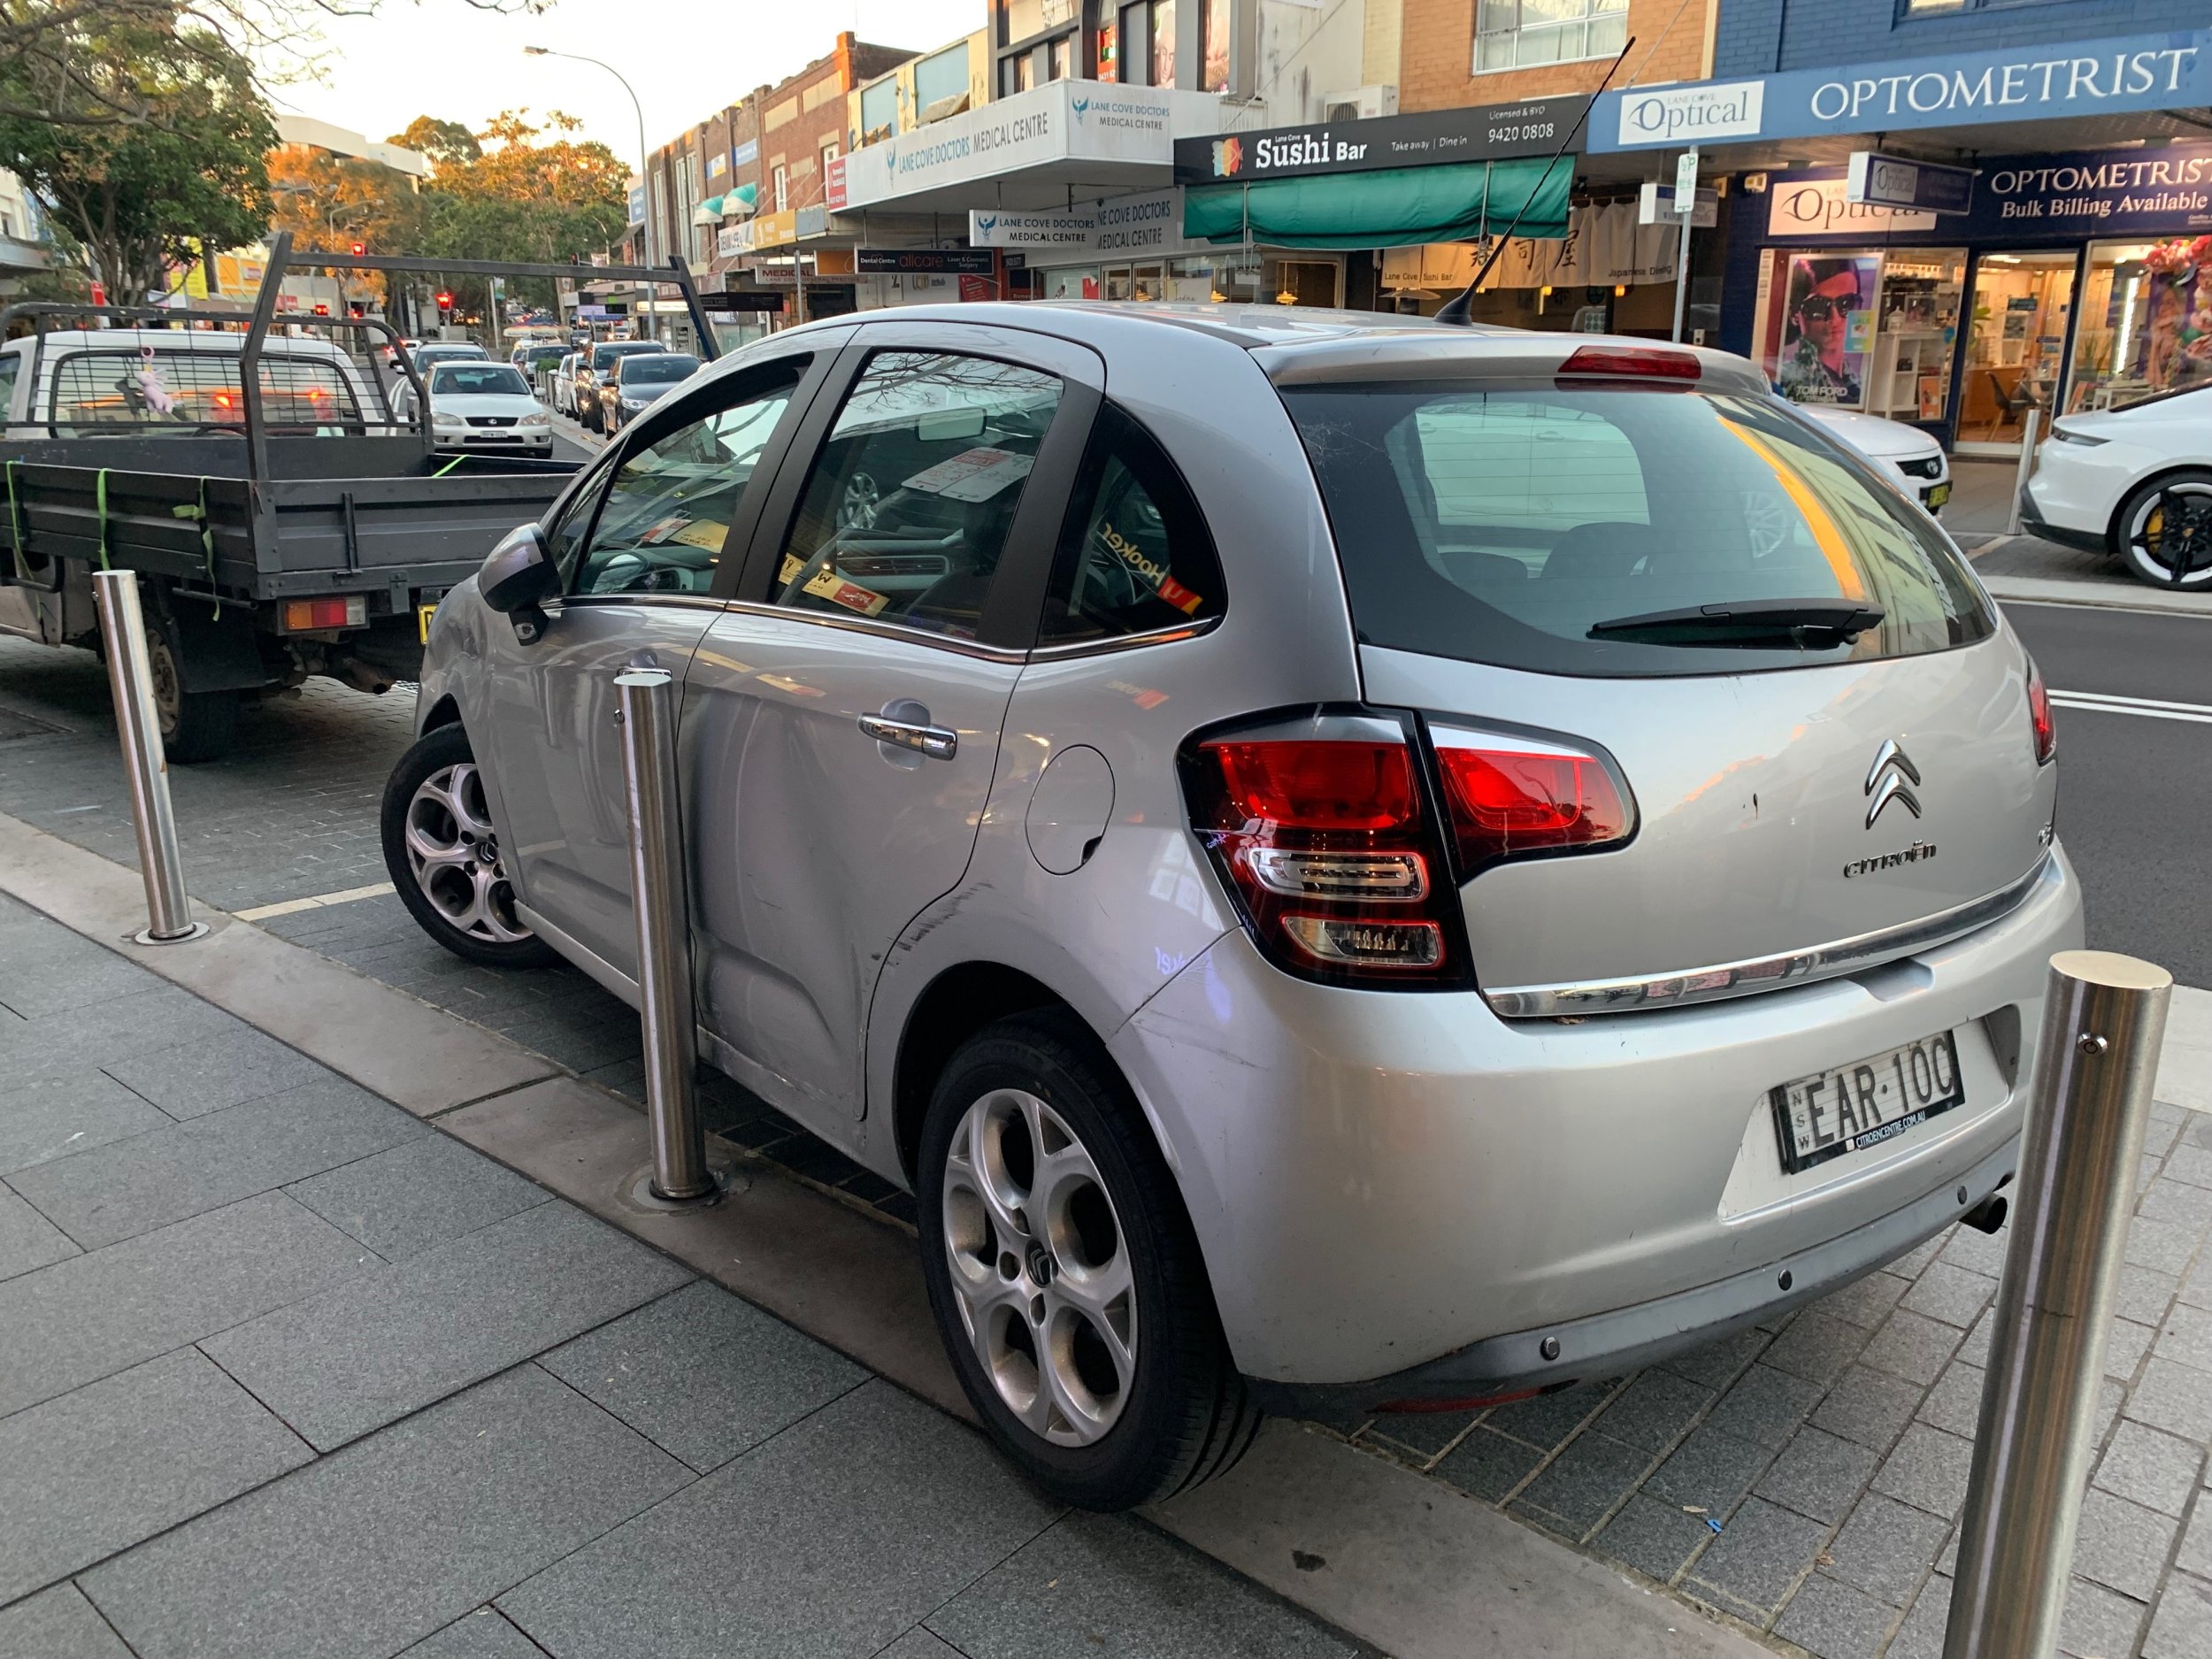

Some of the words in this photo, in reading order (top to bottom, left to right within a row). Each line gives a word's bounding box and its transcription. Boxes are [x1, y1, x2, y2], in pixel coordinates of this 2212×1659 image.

[1810, 48, 2199, 120] OPTOMETRIST
[1091, 102, 1110, 111] LANE
[1112, 104, 1133, 113] COVE
[1136, 105, 1170, 117] DOCTORS
[1489, 109, 1521, 120] Licensed
[1522, 107, 1528, 117] &
[1529, 105, 1546, 116] BYO
[1631, 91, 1748, 138] Optical
[1099, 116, 1133, 127] MEDICAL
[1135, 119, 1163, 130] CENTRE
[1488, 126, 1519, 143] 9420
[1522, 122, 1555, 140] 0808
[899, 152, 915, 174] LANE
[915, 147, 934, 169] COVE
[935, 136, 970, 165] DOCTORS
[973, 125, 1010, 154] MEDICAL
[1013, 112, 1048, 142] CENTRE
[1391, 142, 1409, 151] Take
[1409, 141, 1430, 151] away
[1439, 136, 1458, 147] Dine
[1459, 135, 1467, 145] in
[1256, 133, 1330, 169] Sushi
[1336, 142, 1367, 161] Bar
[2001, 199, 2045, 219] Bulk
[2049, 197, 2113, 219] Billing
[2116, 191, 2208, 213] Available
[1109, 209, 1130, 226] COVE
[1133, 200, 1171, 221] DOCTORS
[999, 219, 1021, 227] LANE
[1025, 219, 1049, 227] COVE
[1053, 219, 1094, 229] DOCTORS
[1010, 233, 1051, 242] MEDICAL
[1053, 233, 1086, 242] CENTRE
[1132, 227, 1162, 247] CENTRE
[899, 253, 943, 267] allcare
[1819, 386, 1848, 397] FORD
